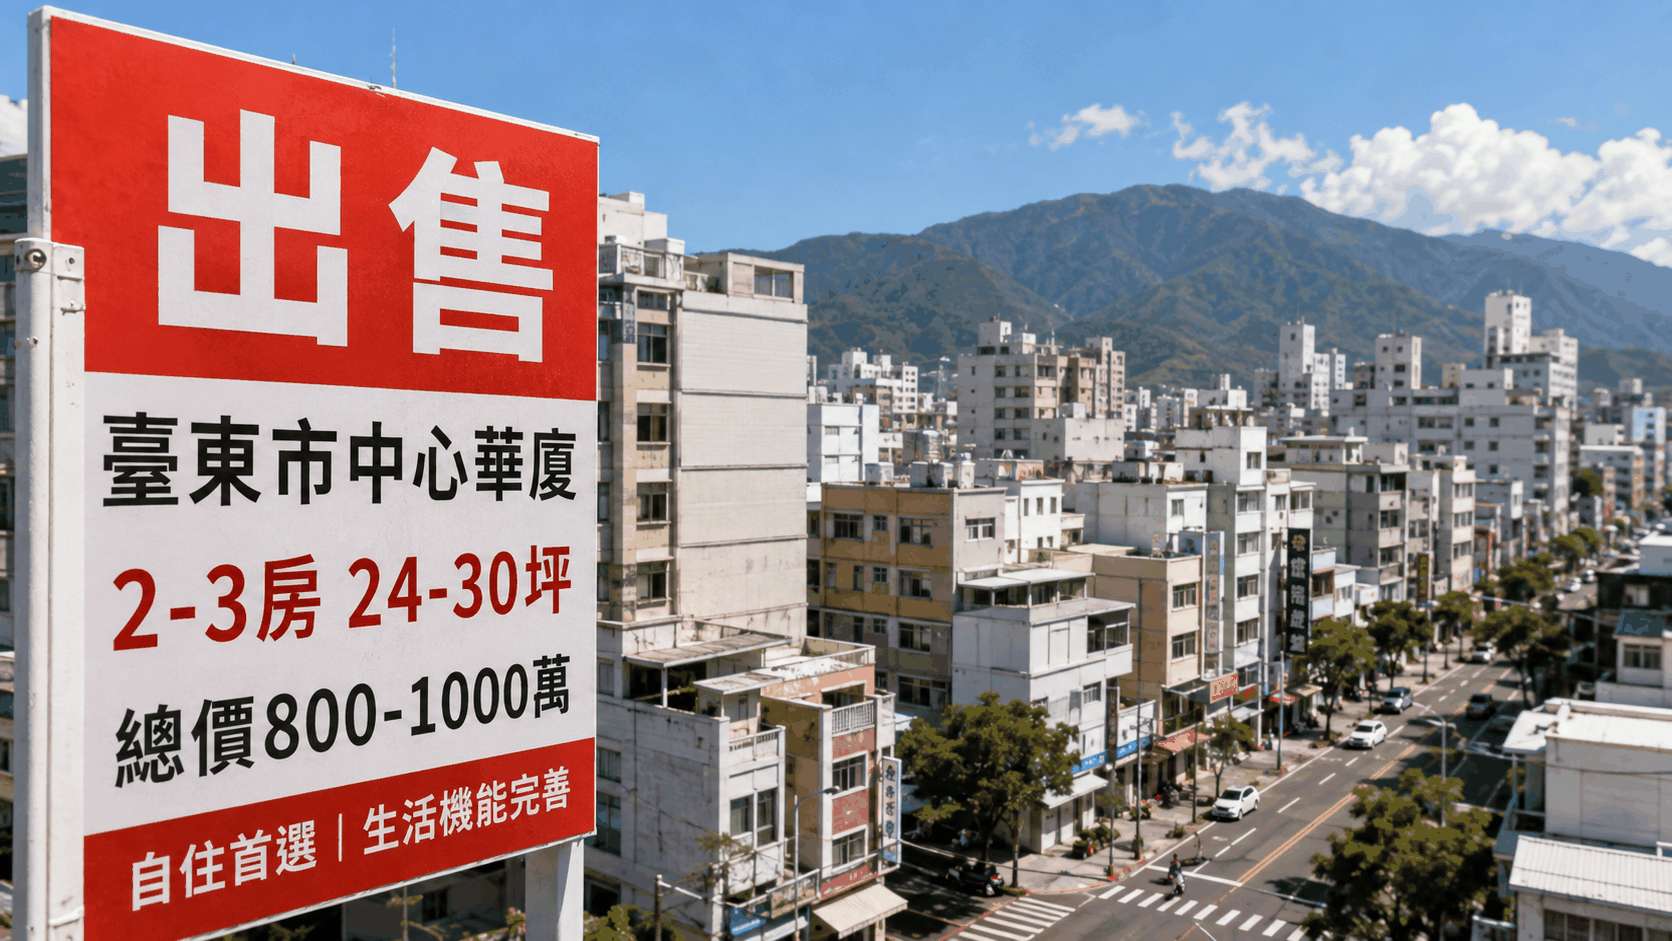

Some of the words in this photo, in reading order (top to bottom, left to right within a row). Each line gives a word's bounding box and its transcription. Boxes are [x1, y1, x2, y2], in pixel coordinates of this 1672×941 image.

[157, 109, 553, 363] 出售
[102, 411, 577, 507] 臺東市中心華廈
[113, 553, 320, 651] 2-3房
[348, 545, 572, 629] 24-30坪
[115, 653, 571, 788] 總價800-1000萬
[131, 818, 317, 912] 自住首選
[363, 766, 571, 855] 生活機能完善
